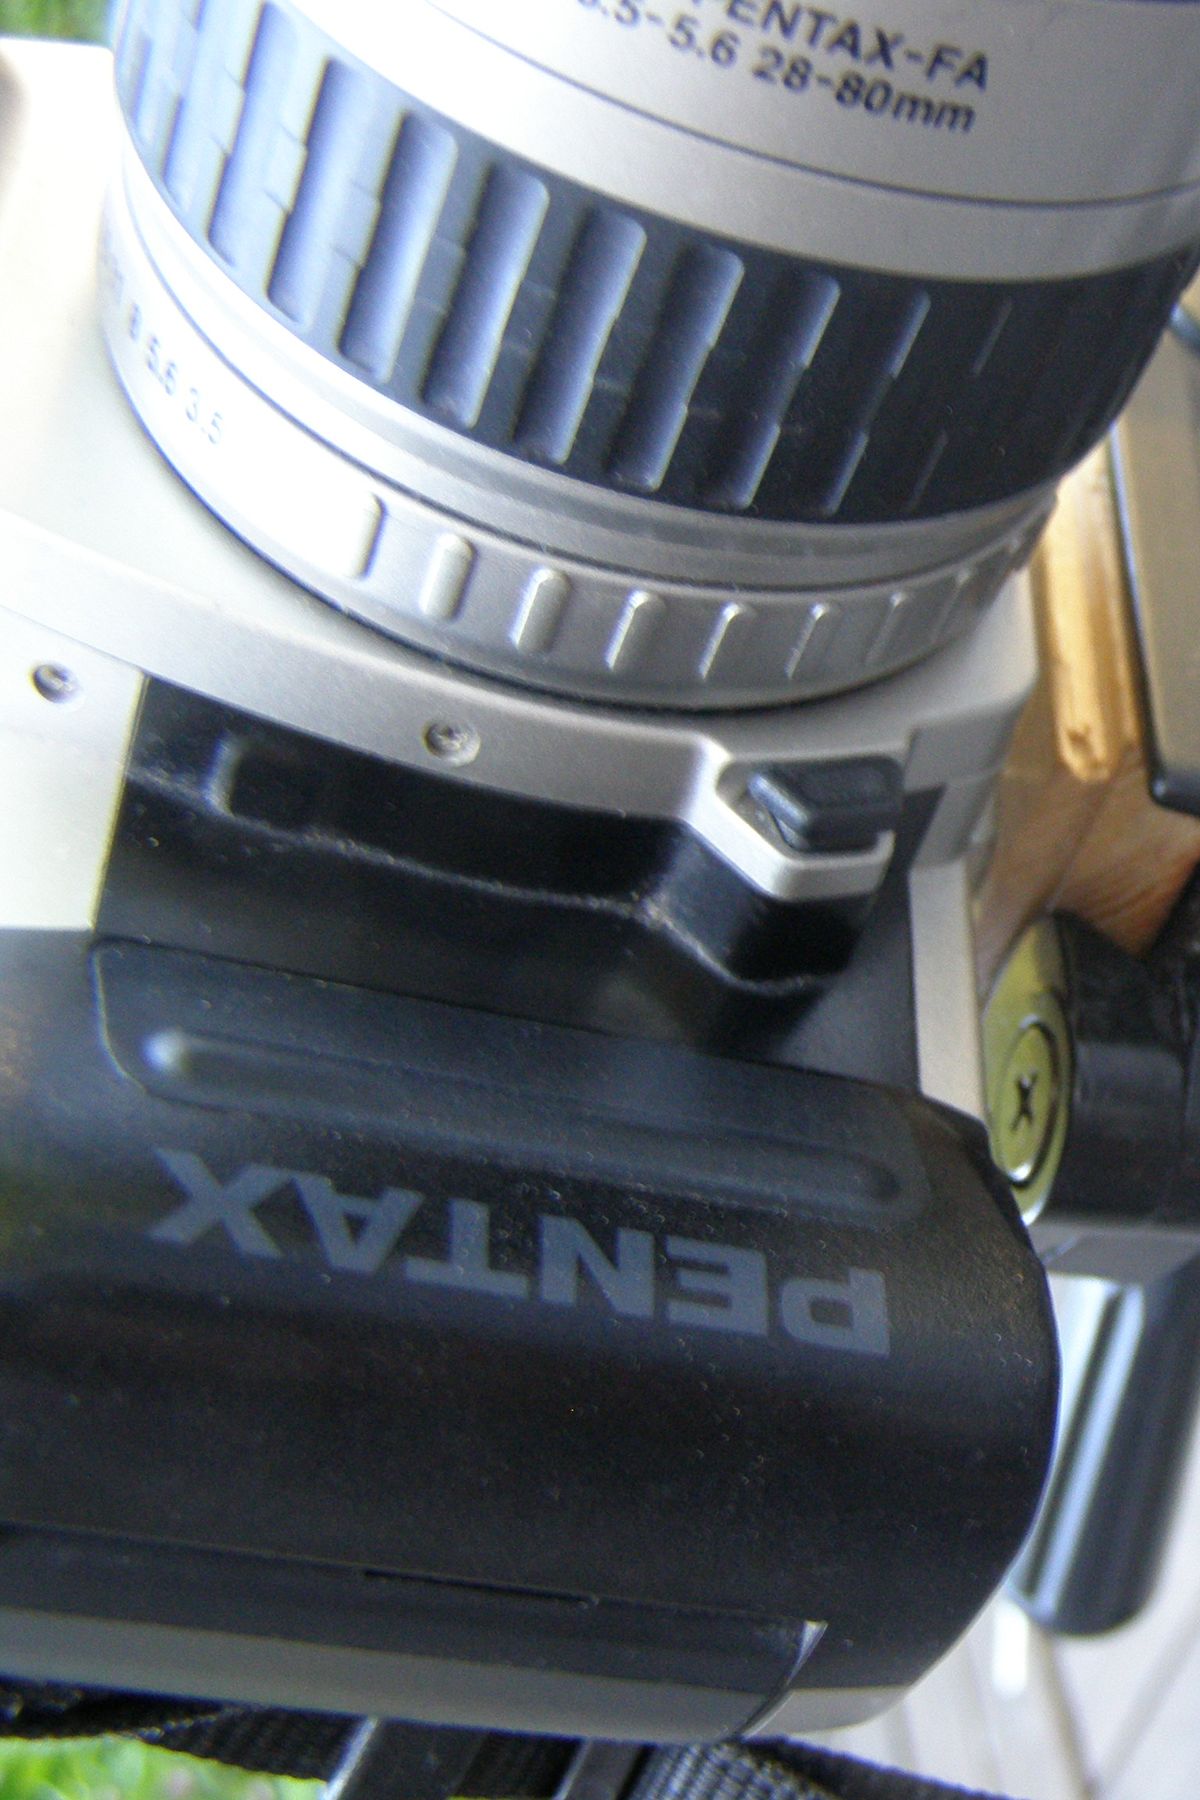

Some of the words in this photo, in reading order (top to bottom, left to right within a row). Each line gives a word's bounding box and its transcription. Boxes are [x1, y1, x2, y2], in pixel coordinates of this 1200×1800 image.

[579, 0, 741, 68] .5-5.6
[752, 45, 976, 132] 28-80mm
[692, 0, 986, 92] ENTAX-FA
[149, 1146, 891, 1357] PENTAX
